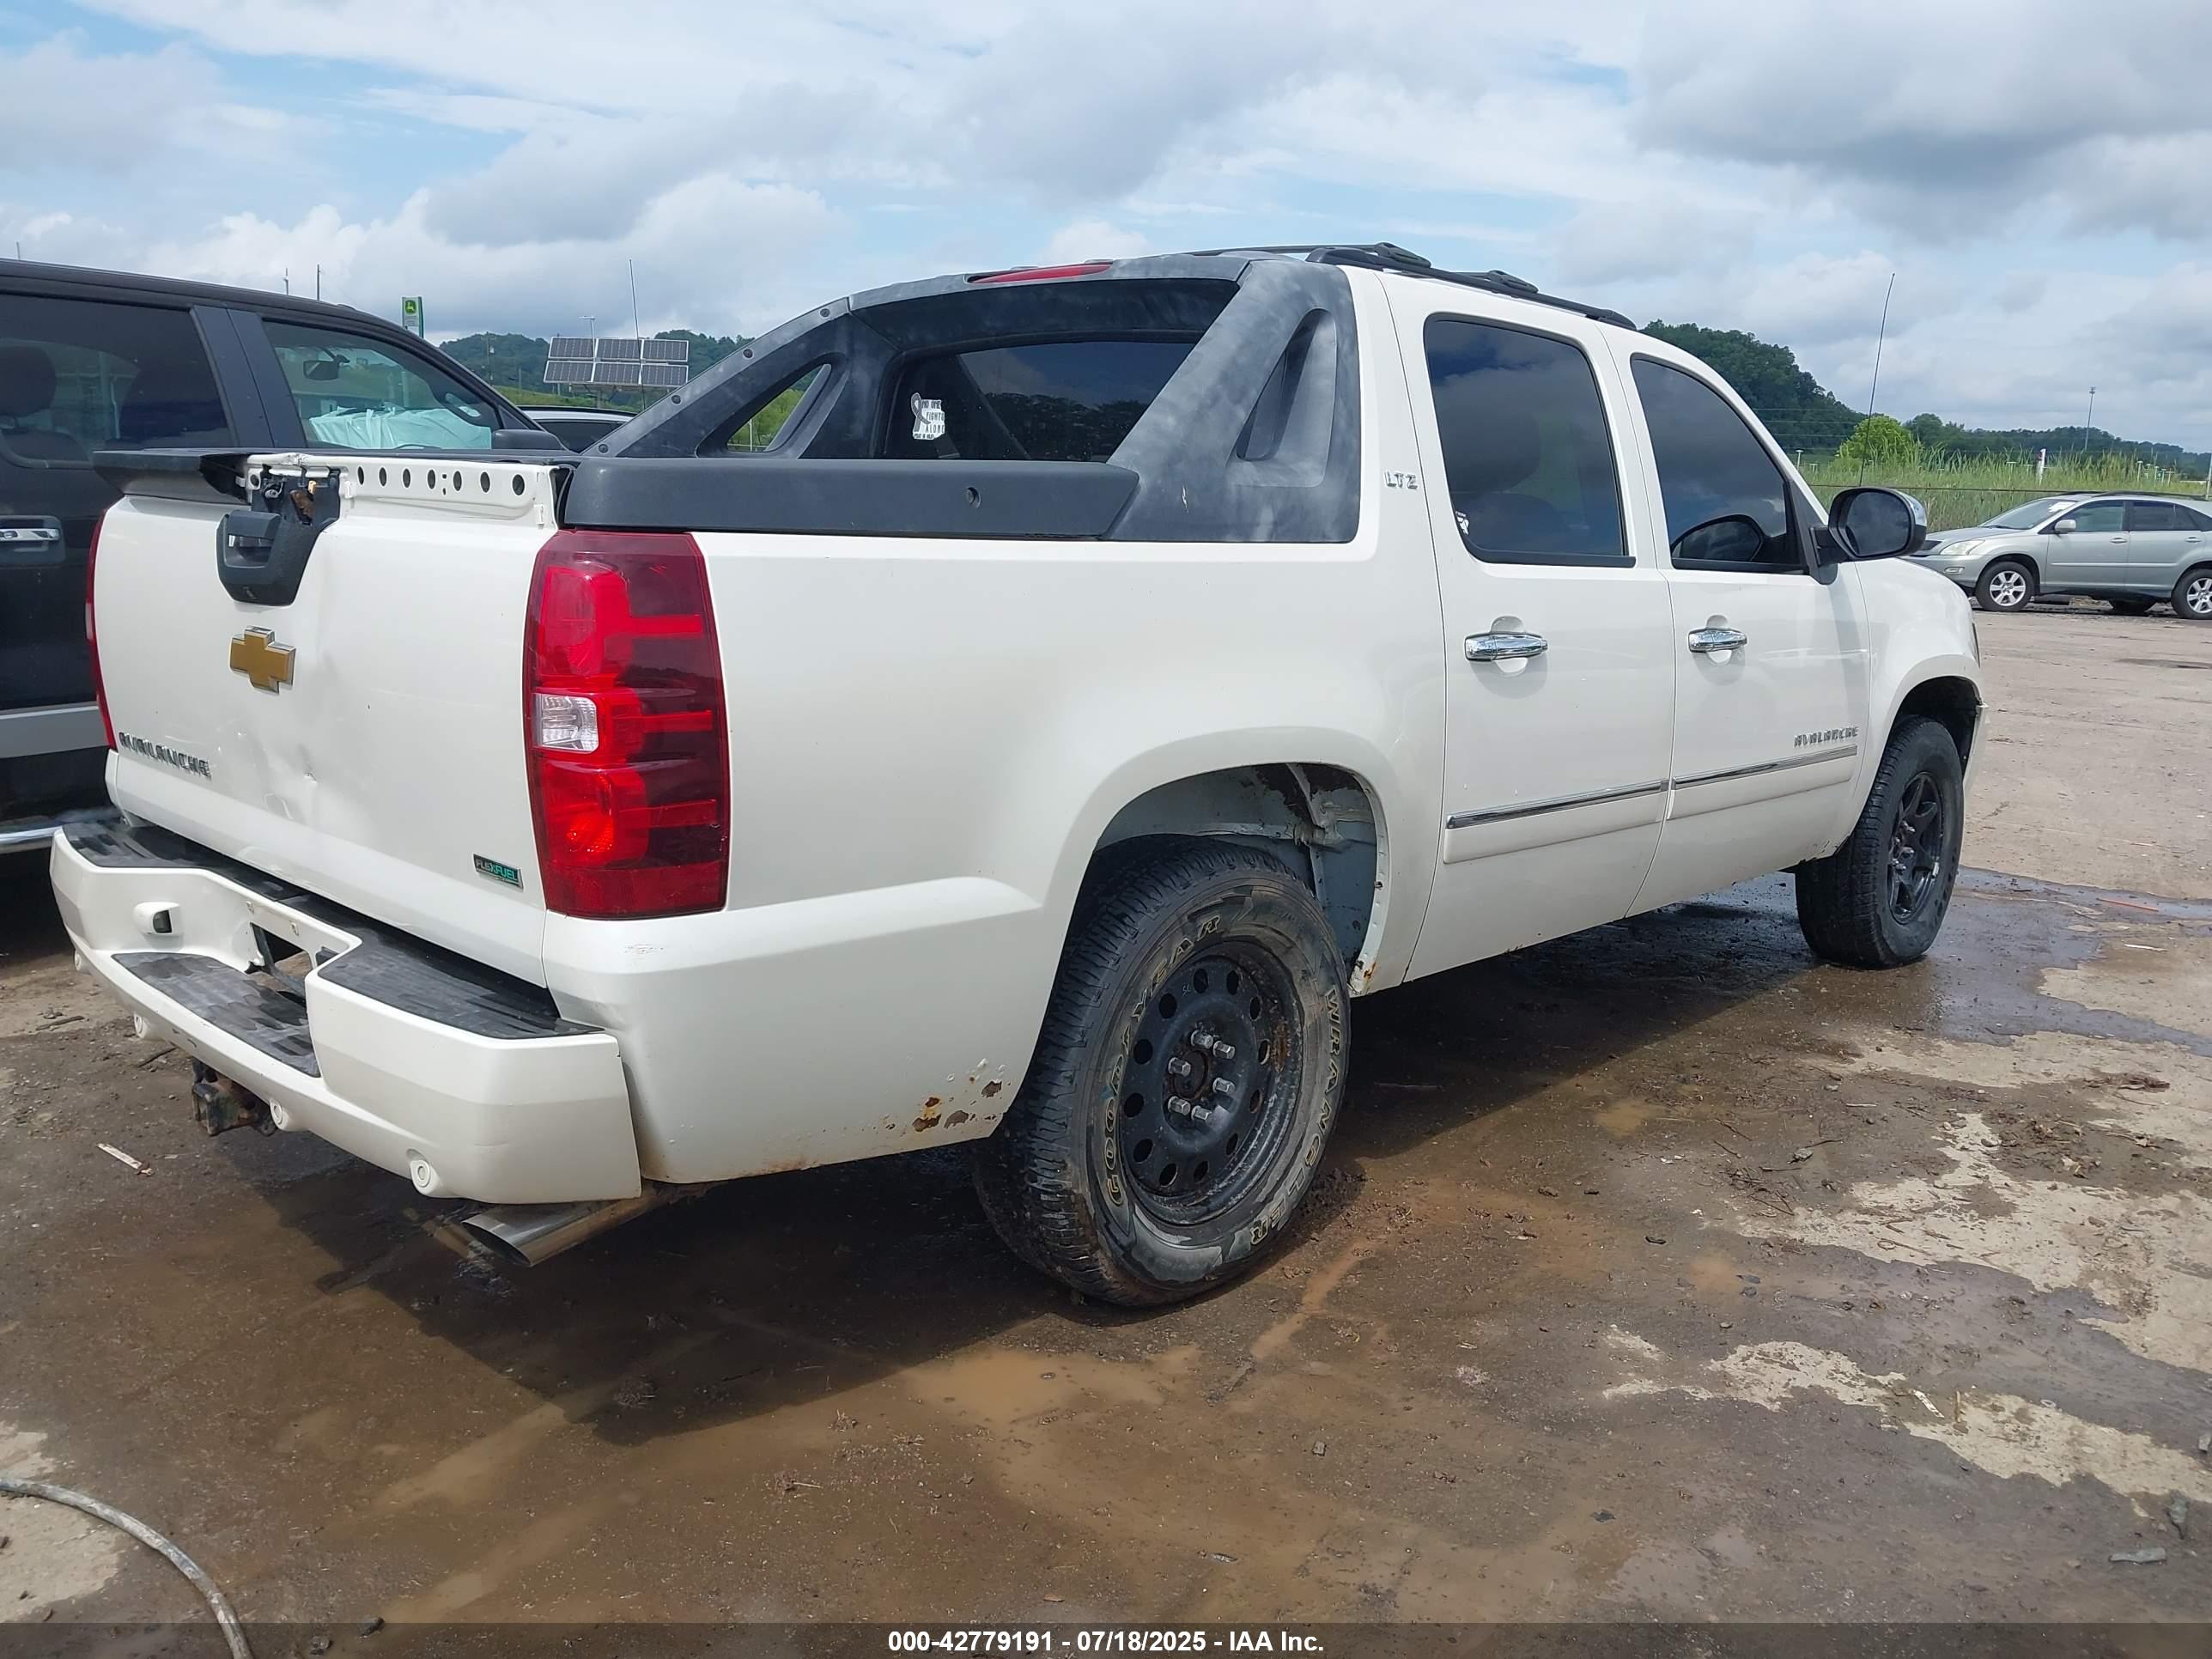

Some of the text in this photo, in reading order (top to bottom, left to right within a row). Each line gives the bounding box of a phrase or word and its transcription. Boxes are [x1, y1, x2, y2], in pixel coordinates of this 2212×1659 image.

[1384, 471, 1419, 489] LTZ
[118, 731, 212, 780] AVALANCHE
[1793, 726, 1861, 748] AVALANCHE
[475, 858, 520, 883] FLEXFUEL
[1104, 914, 1222, 1206] GOODYEAR
[1249, 988, 1342, 1246] WRANGLER
